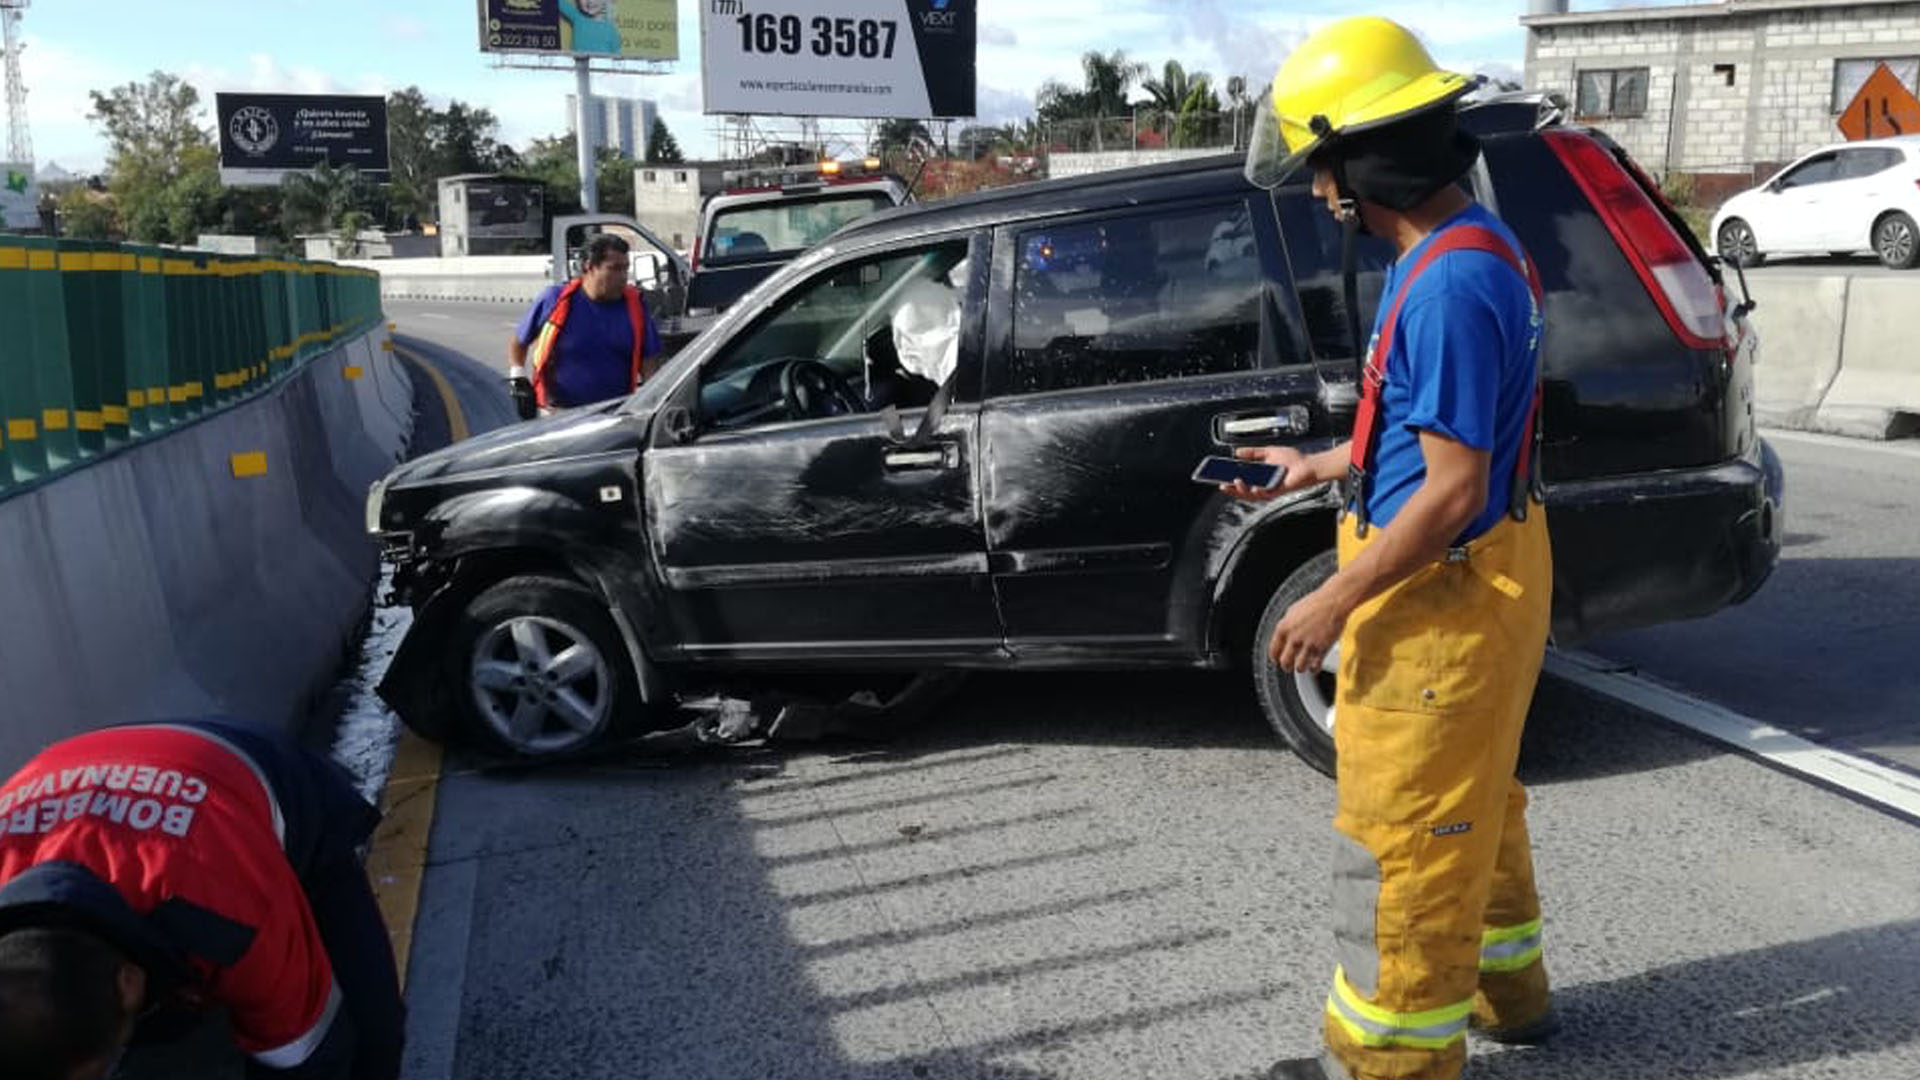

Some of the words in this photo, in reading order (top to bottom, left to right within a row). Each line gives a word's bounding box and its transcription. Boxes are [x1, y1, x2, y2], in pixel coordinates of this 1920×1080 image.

[737, 13, 800, 54] 169
[811, 17, 897, 59] 3587
[918, 11, 957, 25] VEXT
[0, 790, 195, 837] BOMBER
